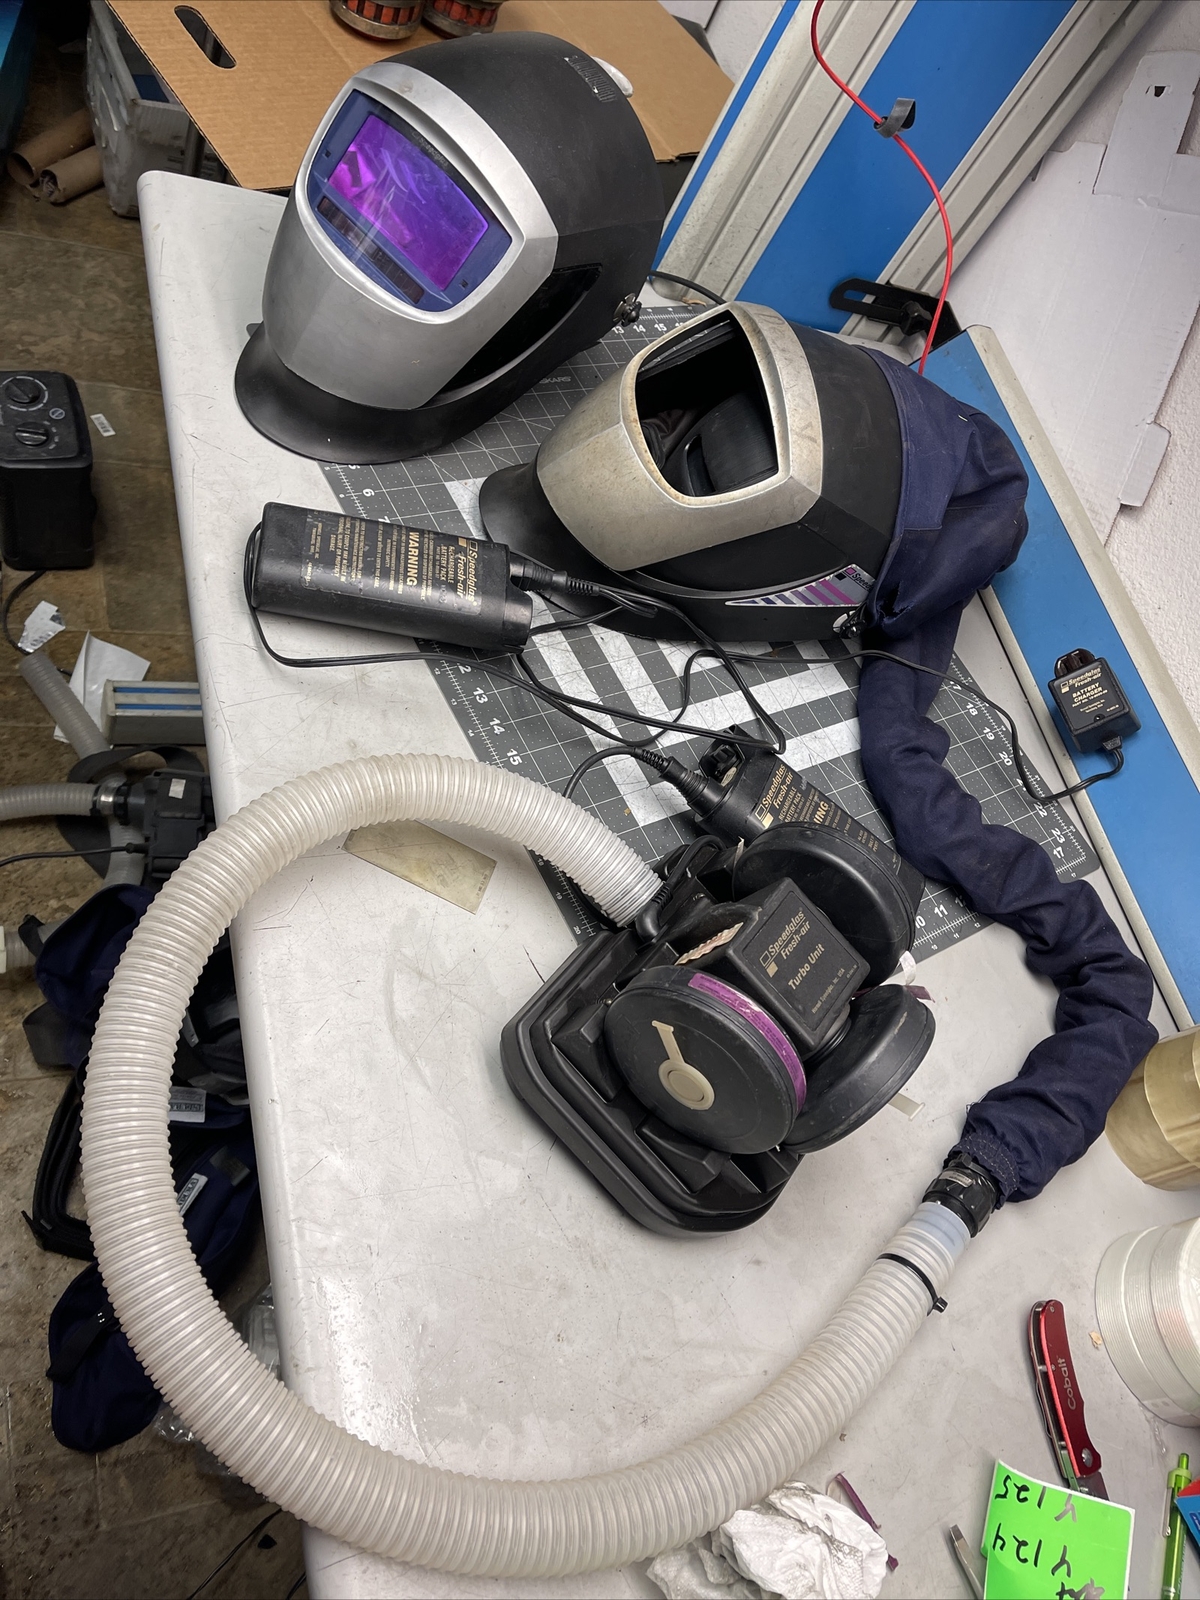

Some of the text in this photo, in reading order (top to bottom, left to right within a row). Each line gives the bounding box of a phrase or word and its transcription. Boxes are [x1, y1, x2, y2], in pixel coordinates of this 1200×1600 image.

[612, 326, 625, 334] 13
[633, 324, 646, 333] 14
[654, 323, 667, 332] 15
[362, 488, 375, 497] 6
[406, 531, 419, 585] WARNING
[456, 554, 466, 598] Fresh-air
[467, 550, 477, 601] Speedglas
[473, 687, 489, 704] 13
[1072, 682, 1099, 698] BATTERY
[1074, 687, 1102, 702] CHARGER
[966, 702, 979, 716] 18
[489, 717, 505, 735] 14
[983, 726, 995, 740] 19
[507, 748, 522, 766] 15
[999, 751, 1013, 766] 20
[762, 764, 786, 807] Speedglas
[773, 772, 793, 808] Fresh-air
[793, 792, 802, 805] PACK
[1033, 802, 1047, 817] 22
[1051, 828, 1065, 843] 23
[1053, 846, 1064, 858] 17
[934, 904, 948, 918] 11
[768, 911, 805, 956] Speedglas
[780, 920, 811, 960] Fresh-air
[788, 943, 825, 990] Turbo Unit
[1057, 1357, 1077, 1411] Cobalt
[995, 1474, 1077, 1523] Y 125
[992, 1522, 1071, 1578] Y 124
